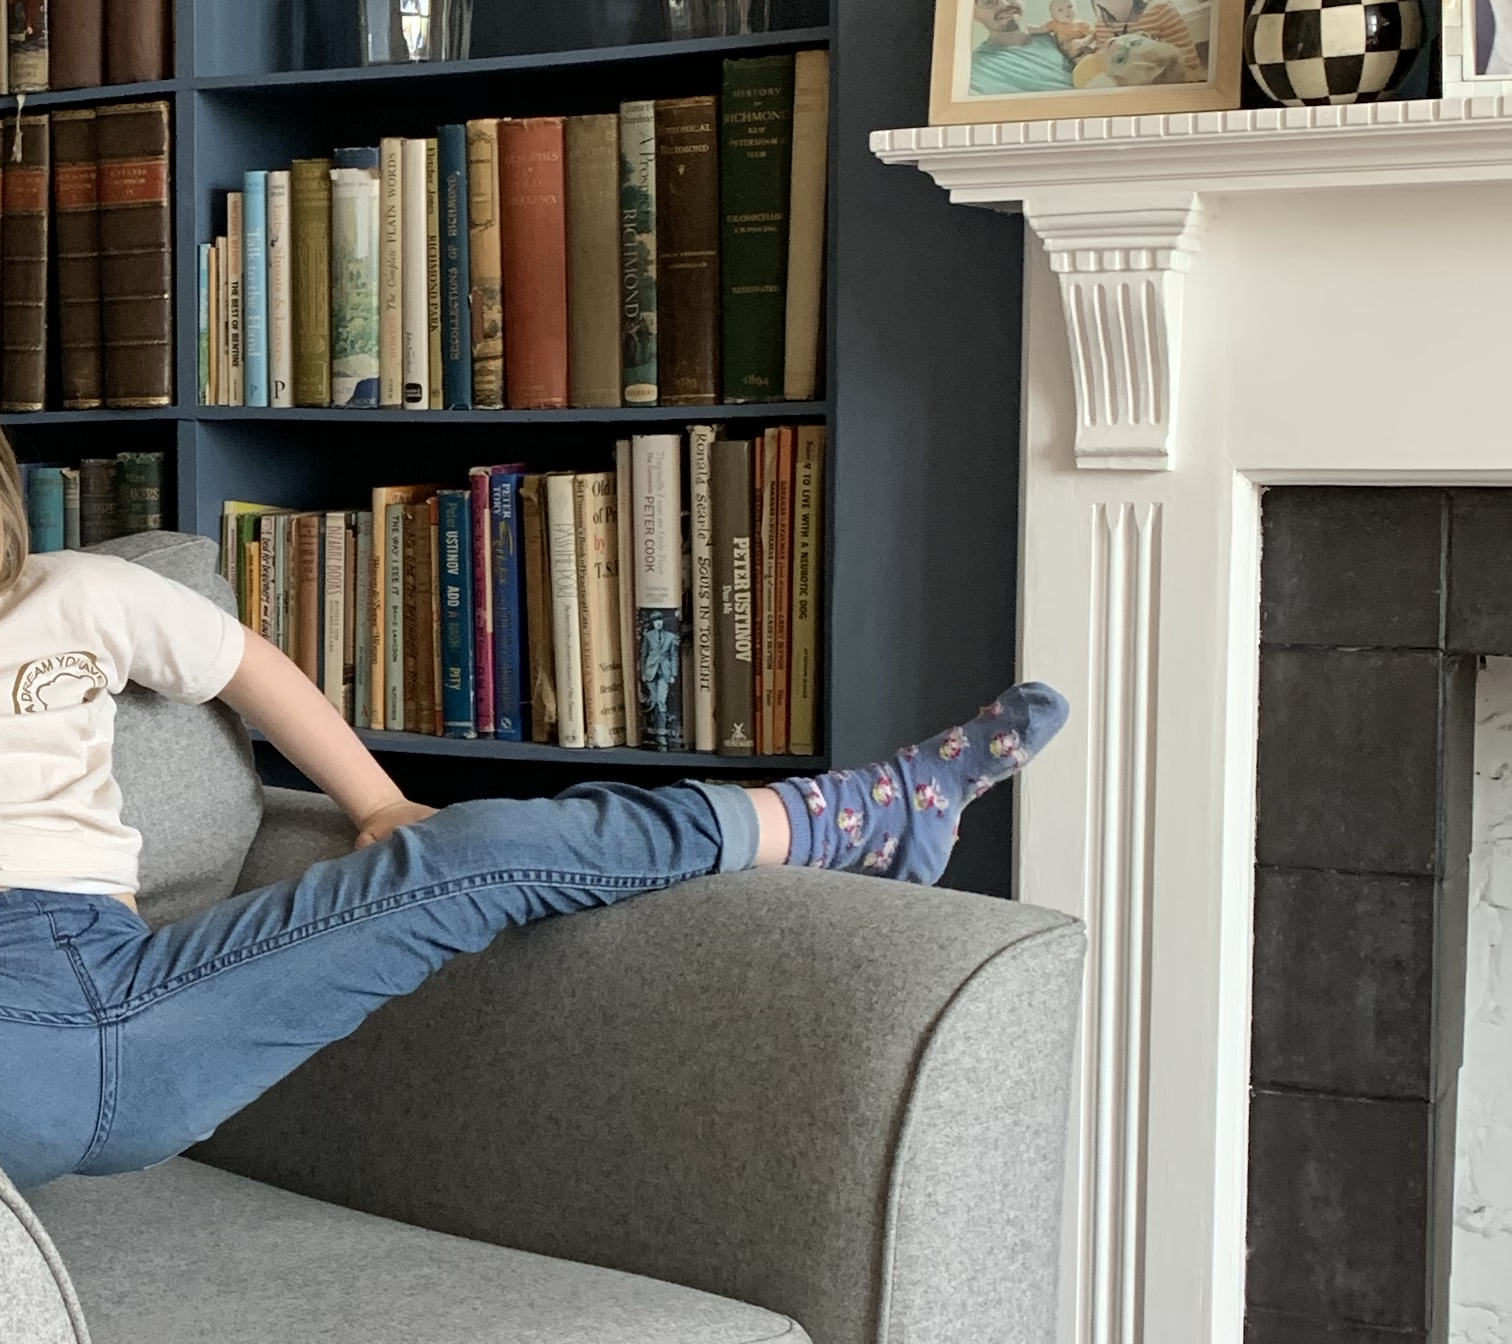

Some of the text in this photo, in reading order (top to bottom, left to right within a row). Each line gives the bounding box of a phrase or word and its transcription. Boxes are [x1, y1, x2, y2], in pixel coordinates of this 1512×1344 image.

[388, 152, 397, 243] PLAIN WORDS
[623, 208, 639, 318] RICHMOND
[231, 281, 239, 297] THE
[428, 235, 438, 332] RICHMOND PARK
[501, 483, 512, 518] PETER
[802, 489, 810, 508] LIVE
[391, 516, 400, 534] THE
[594, 535, 605, 549] by
[644, 496, 656, 573] PETER COOK
[801, 513, 810, 538] WITH
[391, 536, 399, 556] WAY
[695, 433, 712, 692] Ronald Searle SOULS IN TORMENT
[446, 531, 461, 690] USTINOV ADD PITY
[722, 584, 733, 605] Dear
[734, 537, 752, 662] PETER USTINOV
[799, 600, 807, 620] DOG
[21, 659, 54, 713] A DREAM
